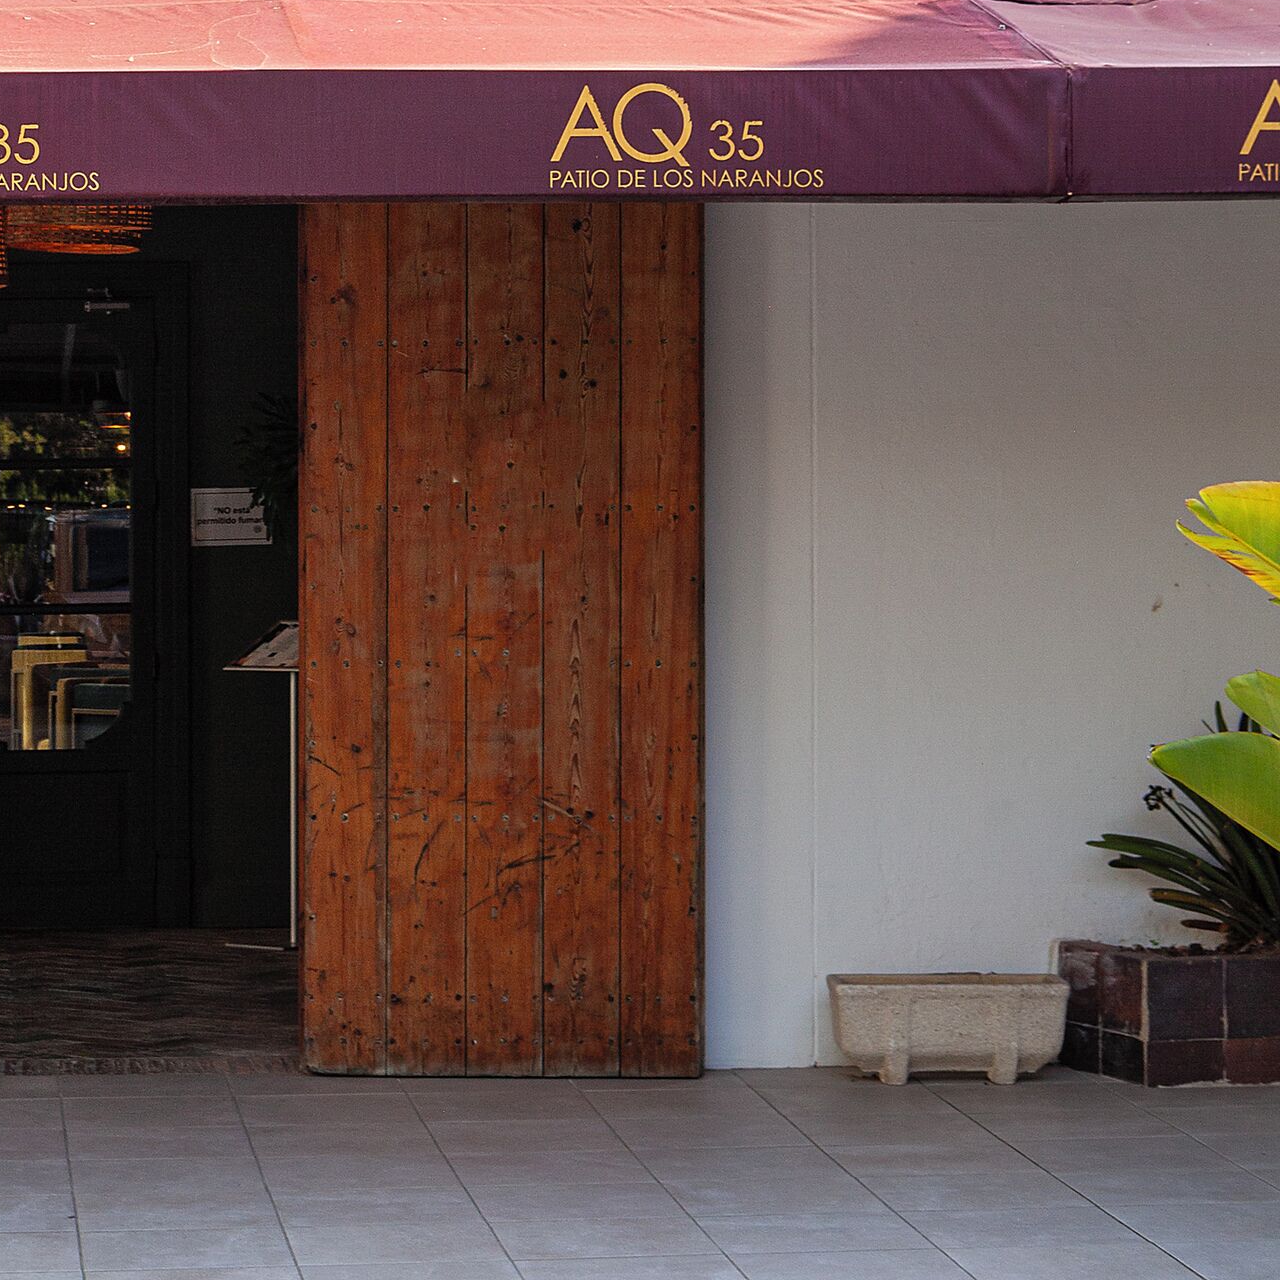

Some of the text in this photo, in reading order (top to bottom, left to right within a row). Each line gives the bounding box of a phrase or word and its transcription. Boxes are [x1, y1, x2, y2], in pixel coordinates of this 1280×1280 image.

[550, 83, 764, 167] AQ 35
[1239, 79, 1280, 155] A
[549, 168, 824, 189] PATIO DE LOS NARANJOS
[1238, 163, 1280, 181] PATI
